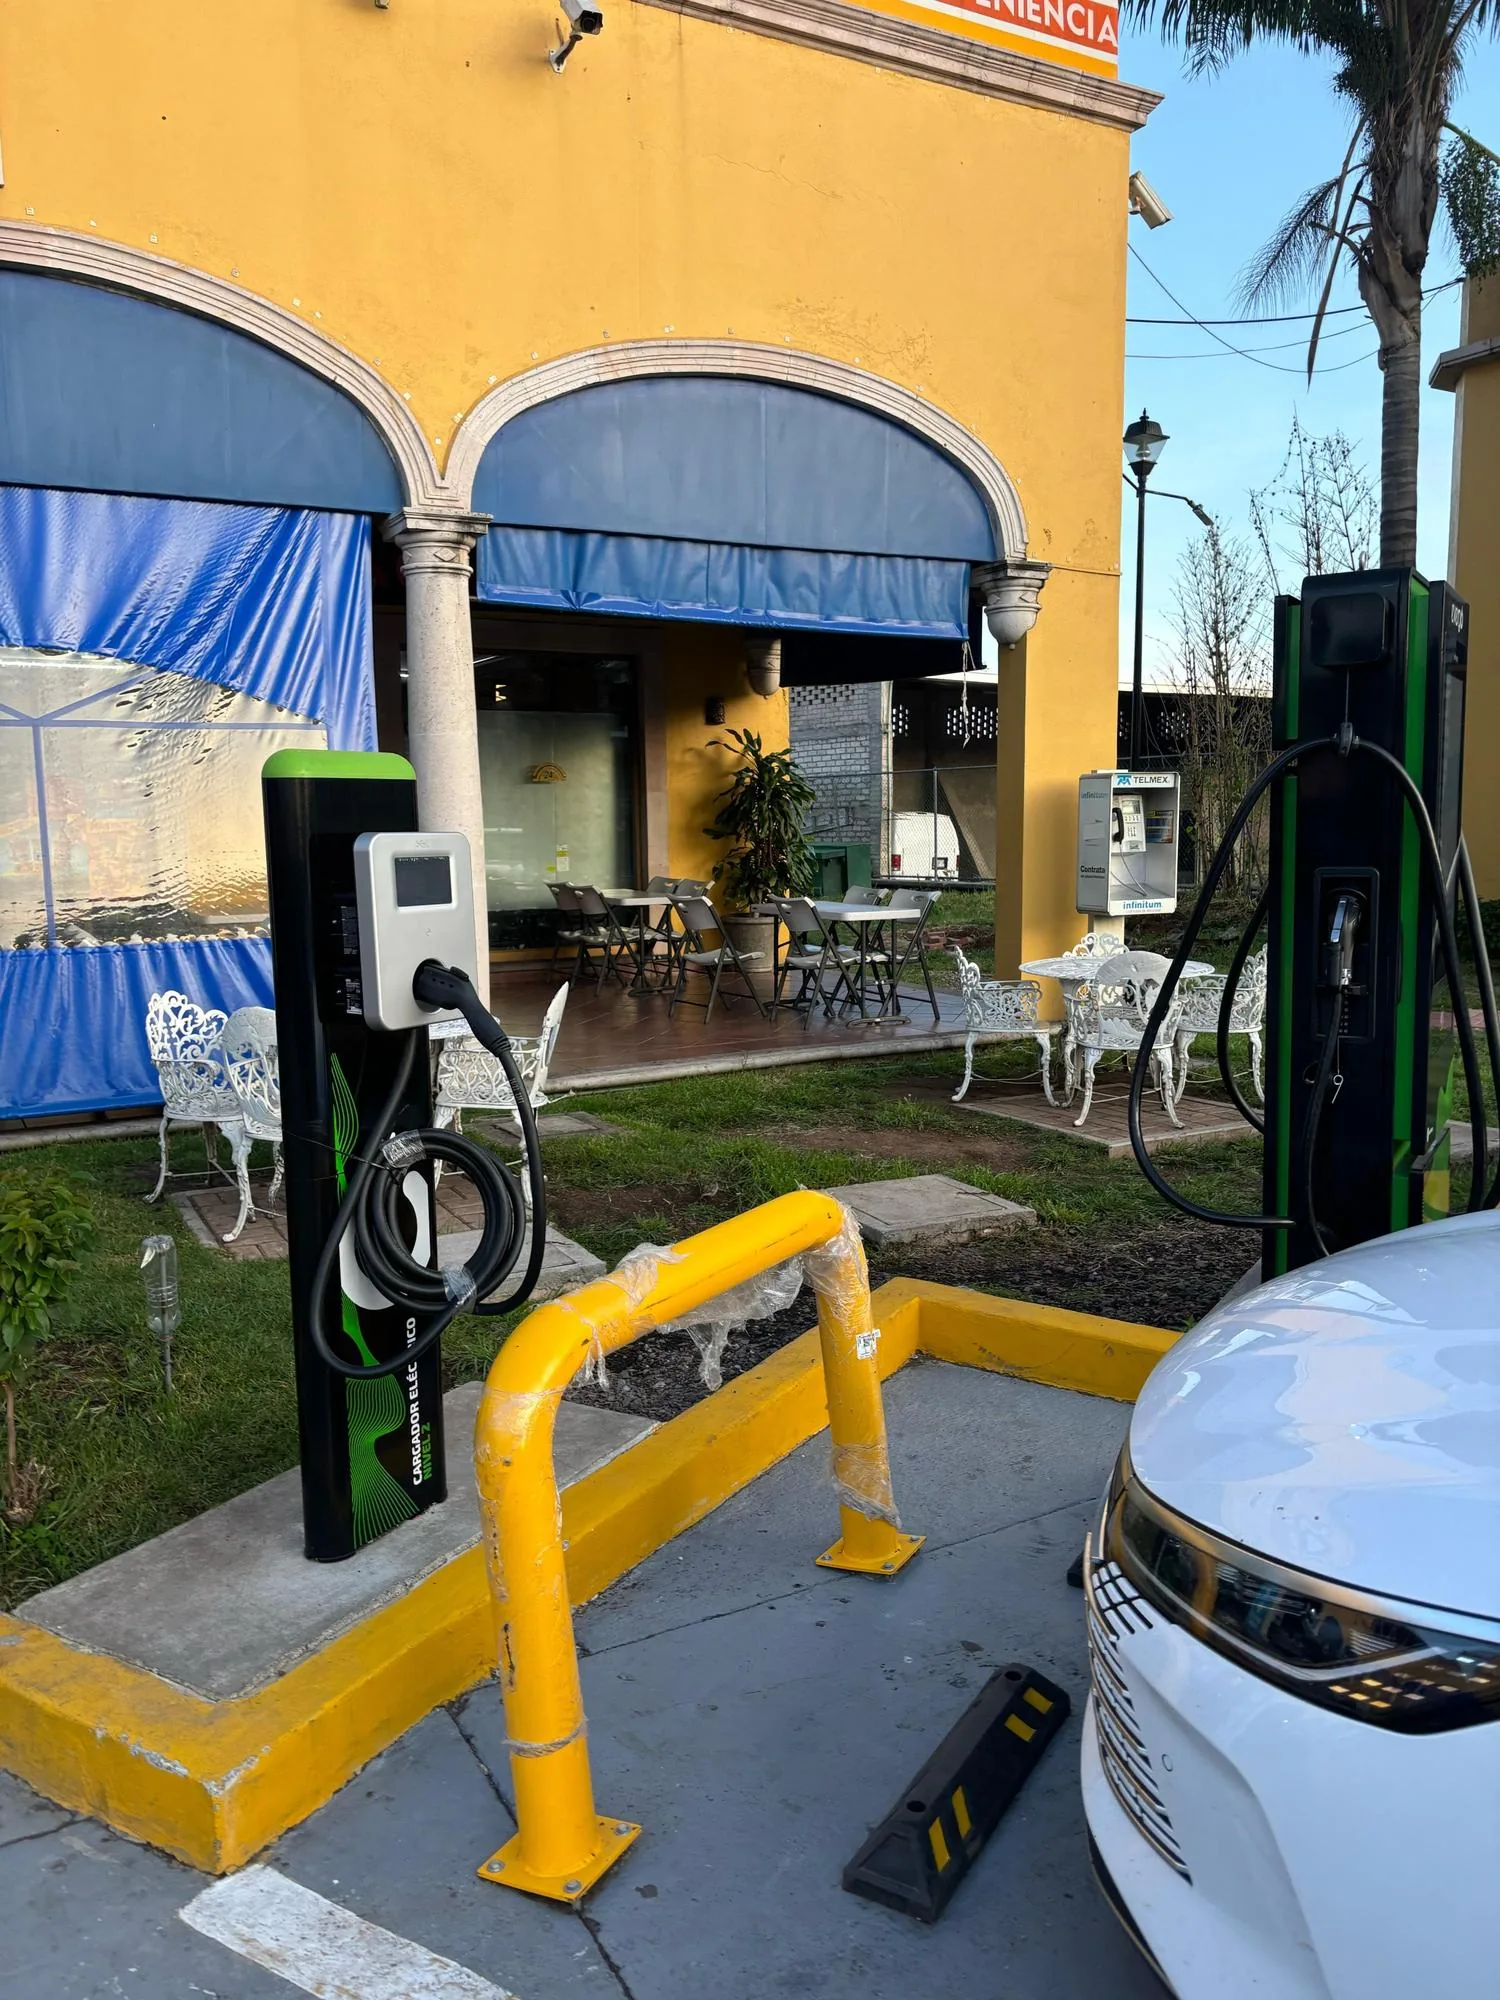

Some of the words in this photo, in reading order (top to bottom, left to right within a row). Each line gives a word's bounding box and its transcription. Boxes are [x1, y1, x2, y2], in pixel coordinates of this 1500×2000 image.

[976, 0, 1118, 48] IENCIA
[1133, 776, 1169, 784] TELMEX
[1080, 865, 1105, 874] Contrata
[1123, 901, 1162, 909] infinitum
[406, 1317, 418, 1400] ELÉCICO
[421, 1422, 431, 1431] 2
[410, 1401, 422, 1486] CARGADOR
[422, 1434, 433, 1480] NIVEL
